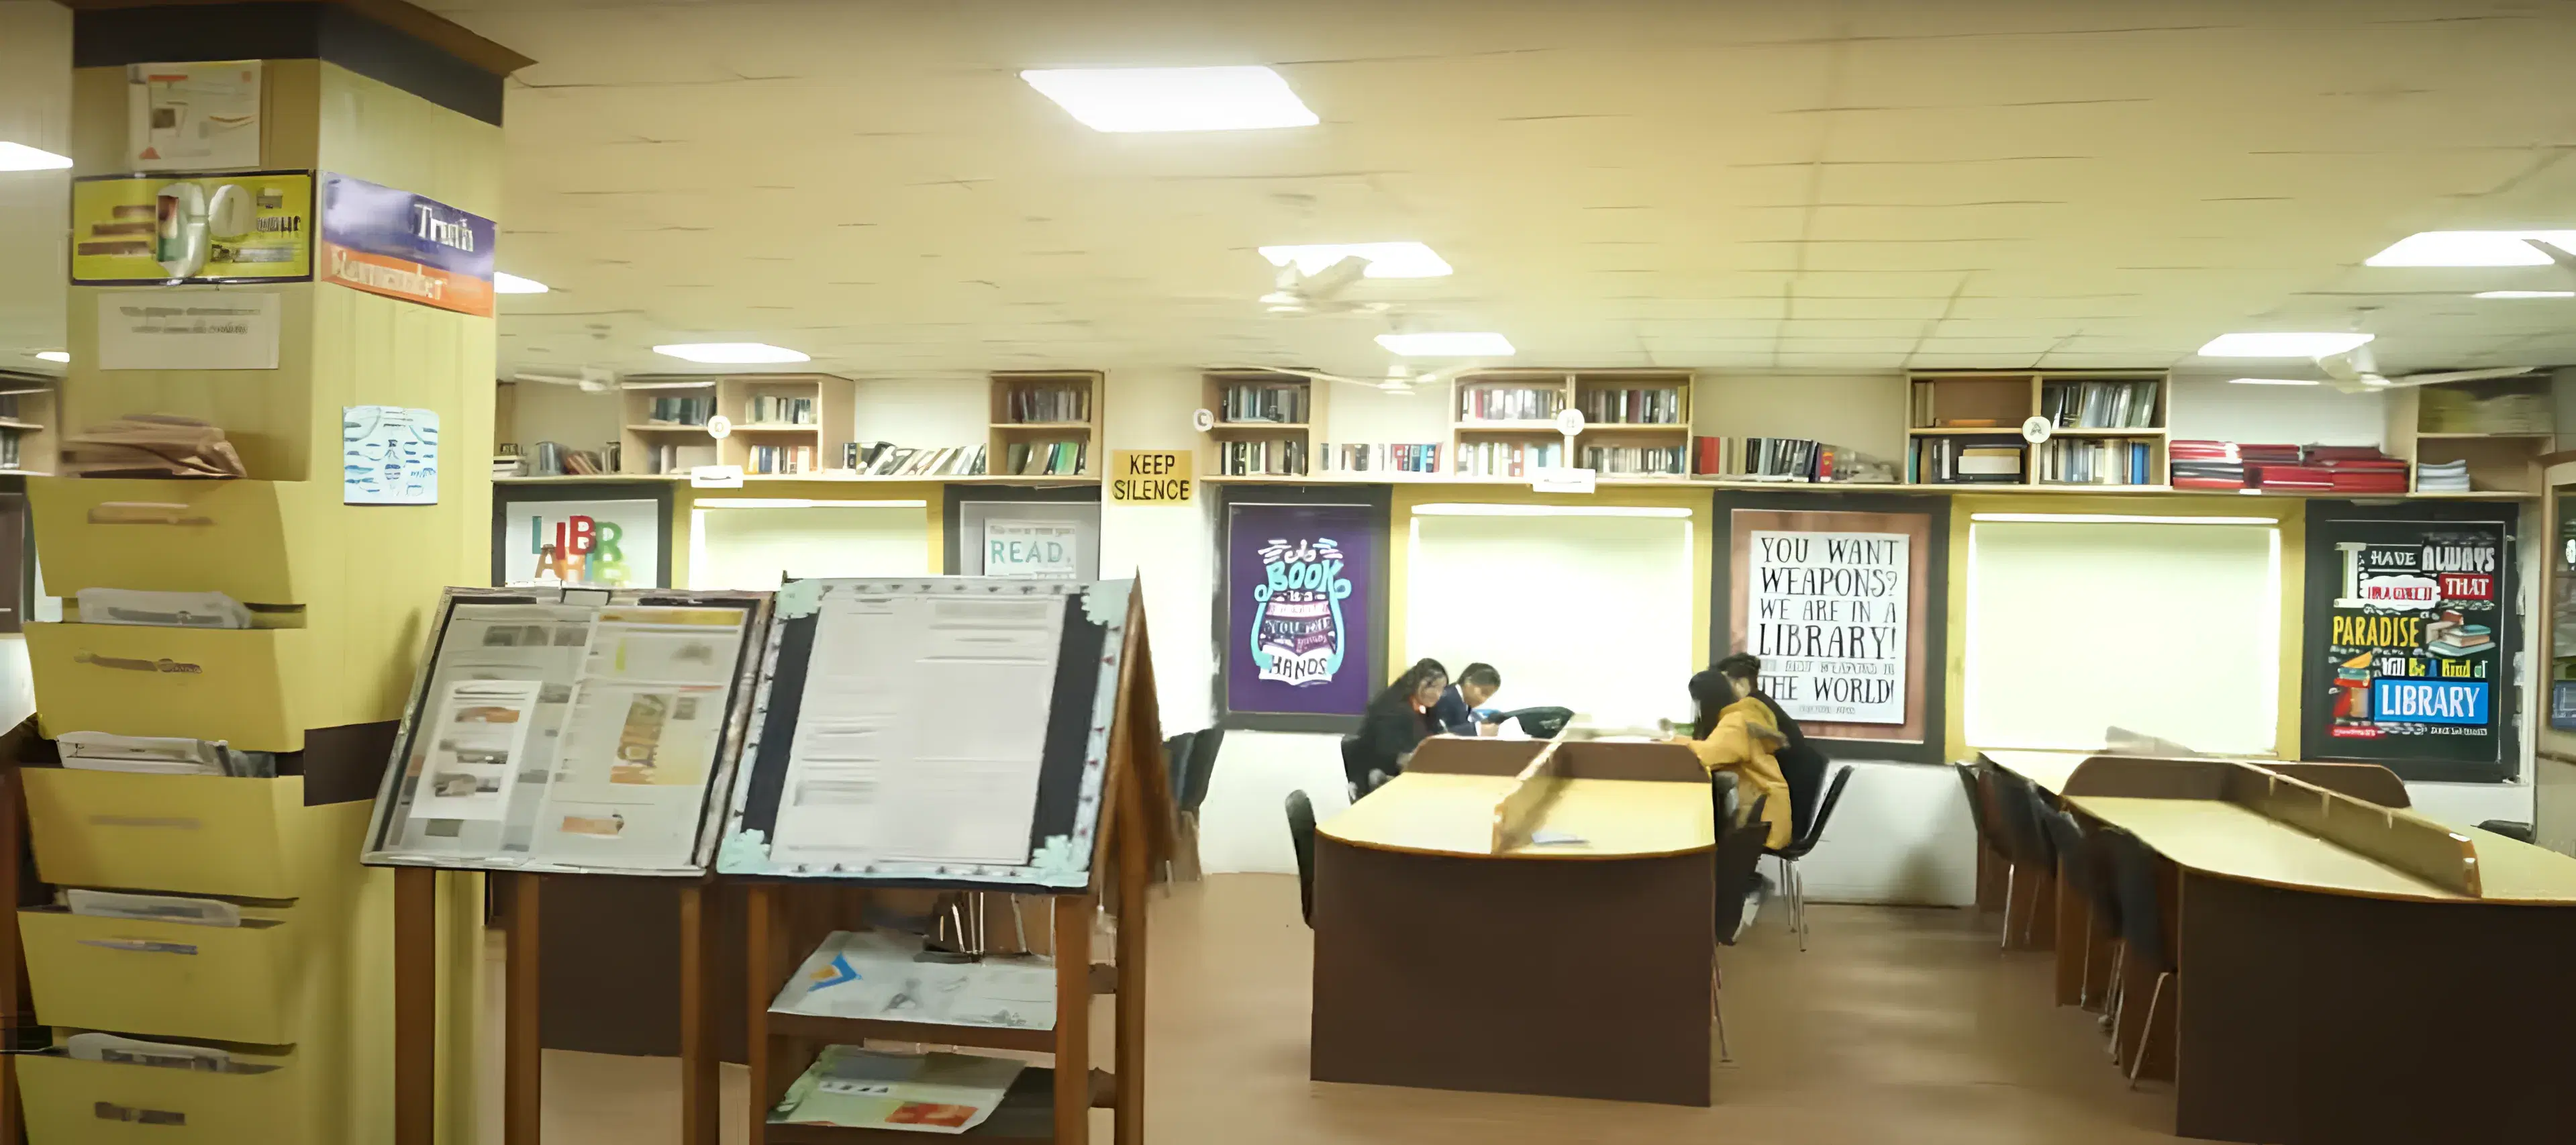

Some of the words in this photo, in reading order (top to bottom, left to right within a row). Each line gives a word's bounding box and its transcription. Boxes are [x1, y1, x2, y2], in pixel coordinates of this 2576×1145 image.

[2030, 421, 2044, 436] A
[1130, 454, 1175, 475] KEEP
[1113, 479, 1189, 500] SILENCE
[1761, 537, 1809, 562] YOU
[1827, 539, 1899, 565] WANT
[2370, 550, 2417, 566] HAVE
[2422, 545, 2495, 572] ALWAYS
[1266, 559, 1344, 592] BOOK
[1761, 566, 1897, 597] WEAPONS?
[2445, 577, 2489, 596] THAT
[1761, 598, 1791, 620] WE
[1803, 600, 1839, 621] ARE
[1851, 601, 1871, 622] IN
[1883, 602, 1896, 623] A
[1758, 623, 1897, 660] LIBRARY!
[2332, 615, 2420, 647] PARADISE
[1269, 656, 1327, 679] HANDS
[1758, 675, 1799, 700] THE
[1814, 677, 1895, 705] WORLD!
[2382, 685, 2481, 717] LIBRARY
